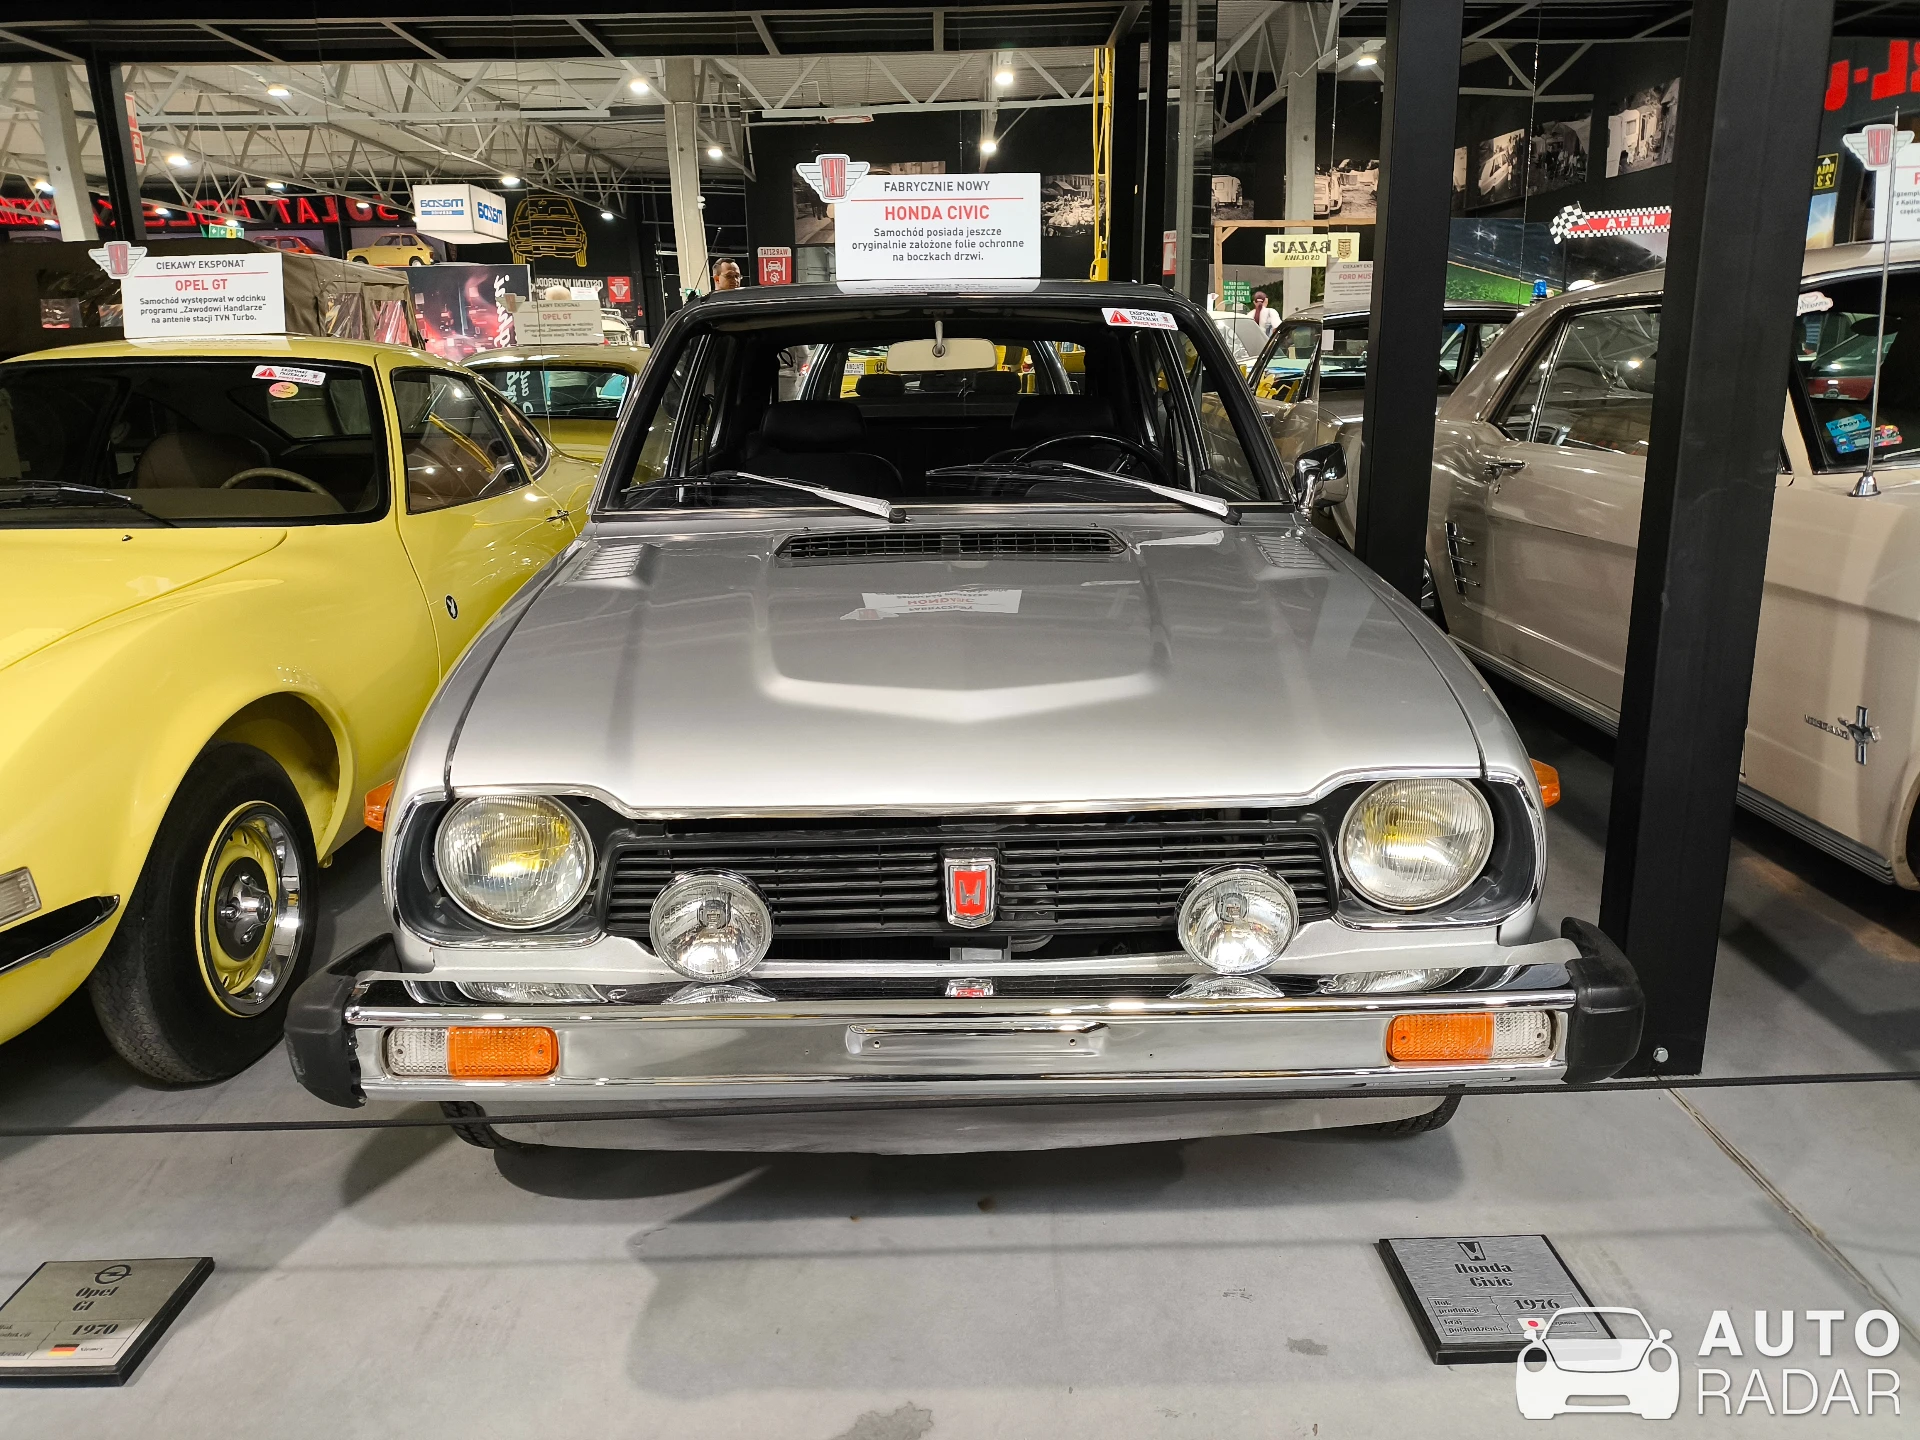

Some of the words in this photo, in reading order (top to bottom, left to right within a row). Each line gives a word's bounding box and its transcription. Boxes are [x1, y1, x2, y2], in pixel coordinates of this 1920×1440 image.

[884, 181, 953, 192] FABRYCZNIE
[956, 180, 990, 191] NOWY
[885, 206, 942, 220] HONDA
[947, 205, 990, 219] CIVIC
[873, 227, 924, 237] Samochód
[926, 227, 964, 238] posiada
[966, 227, 1002, 238] jeszcze
[852, 240, 907, 250] oryginalnie
[909, 239, 952, 249] założone
[955, 239, 976, 248] folie
[979, 239, 1024, 248] ochronne
[907, 252, 951, 261] boczkach
[954, 251, 984, 261] drzwi.
[156, 260, 196, 270] CIEKAWY
[198, 259, 245, 269] EKSPONAT
[175, 279, 208, 291] OPEL
[212, 279, 228, 290] GT
[139, 296, 179, 305] Samochód
[180, 296, 226, 306] występował
[235, 294, 266, 302] odcinku
[140, 307, 178, 316] programu
[180, 304, 222, 314] „Zawodowi
[162, 315, 191, 323] antenie
[192, 314, 213, 323] stacji
[214, 314, 230, 322] TVN
[232, 313, 257, 321] Turbo.
[1454, 1263, 1513, 1274] Honda
[1469, 1276, 1513, 1287] Civic
[75, 1286, 119, 1298] Opel
[1513, 1299, 1561, 1310] 1976
[72, 1324, 119, 1335] 1970
